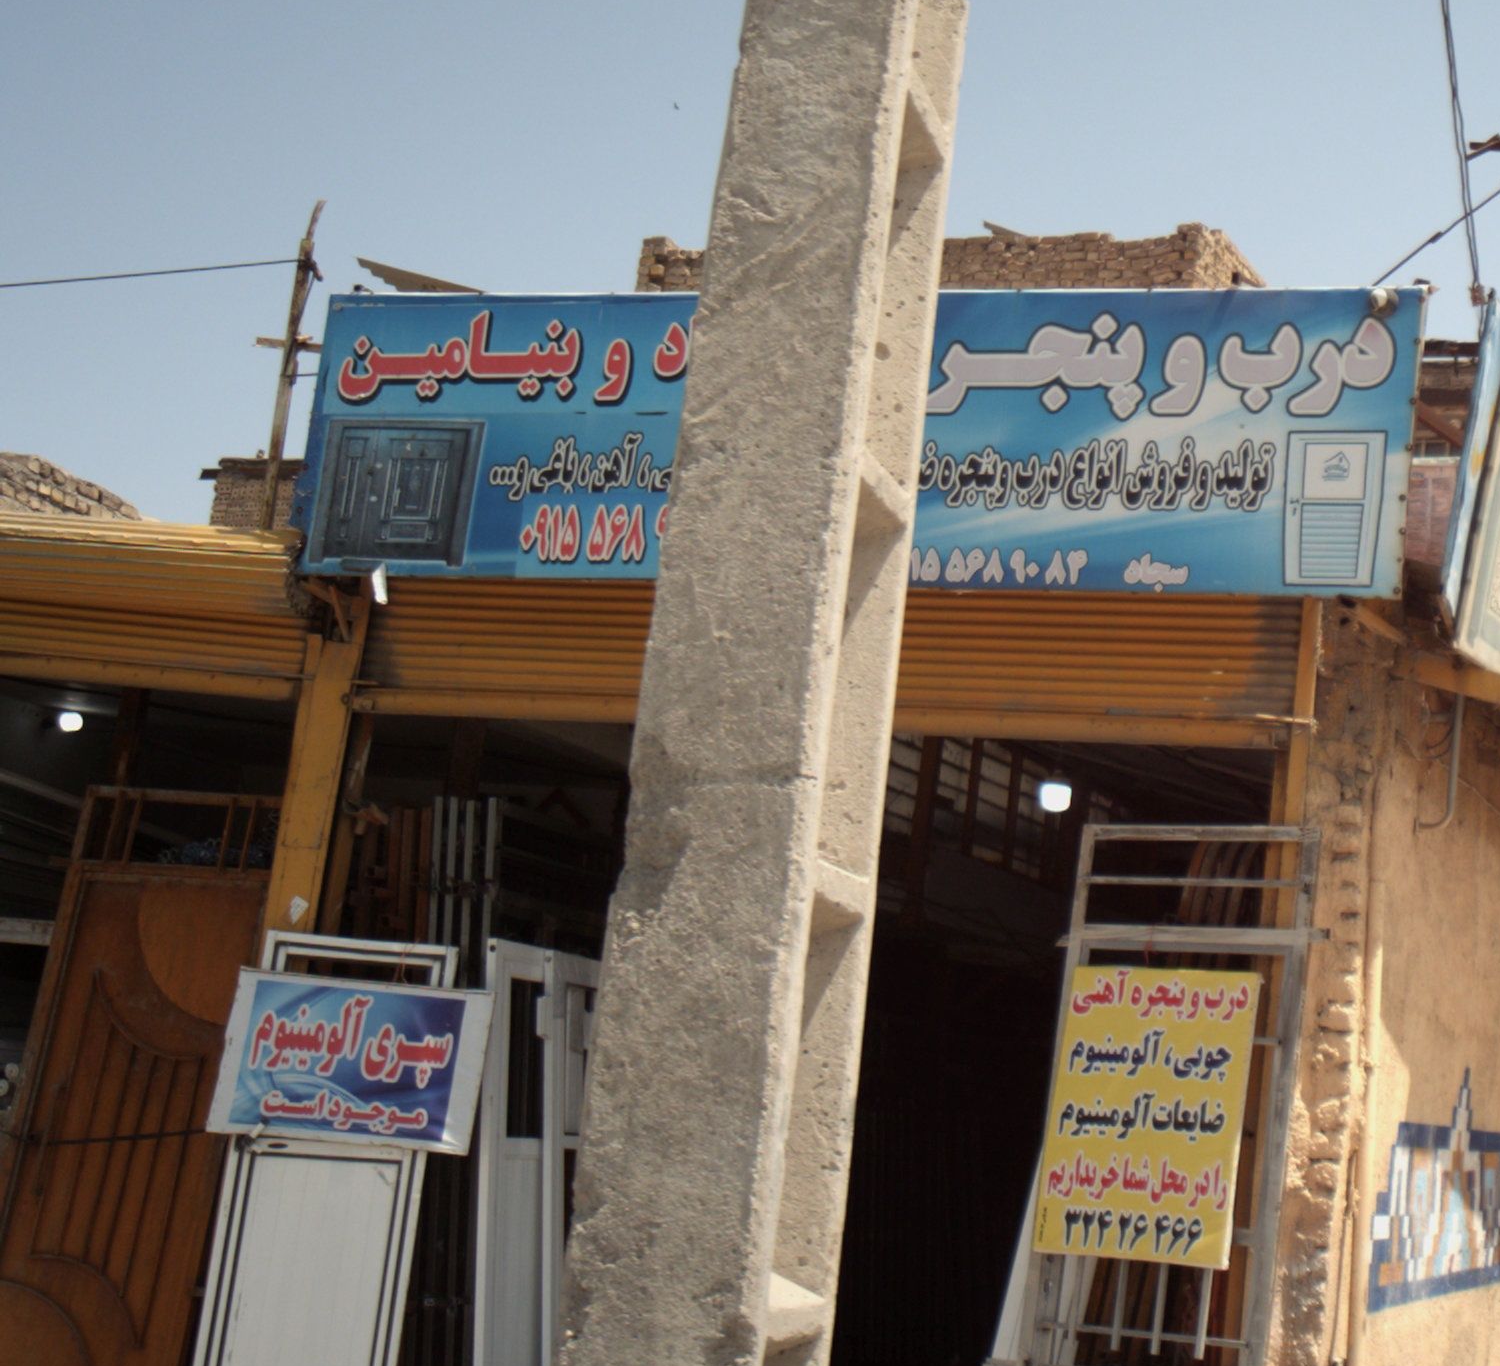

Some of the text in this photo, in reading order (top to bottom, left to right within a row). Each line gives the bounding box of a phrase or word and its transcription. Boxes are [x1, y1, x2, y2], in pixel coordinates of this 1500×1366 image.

[338, 310, 580, 400] بنیامین
[595, 339, 631, 401] و
[928, 312, 1145, 420] پنجر
[1150, 333, 1206, 416] و
[1219, 315, 1396, 417] درب
[1014, 449, 1066, 509] درب
[1063, 438, 1128, 511] انواع
[1122, 436, 1196, 510] فروش
[1190, 462, 1213, 511] و
[1213, 439, 1276, 512] تولید
[520, 504, 580, 561] ۰۹۱۵
[586, 504, 645, 561] ۵۶۸
[945, 548, 1004, 583] ۵۶۸
[1124, 553, 1189, 593] سجاد
[1071, 970, 1250, 1021] درب و پنجره آهنی
[249, 994, 453, 1089] سپری آلومینیوم
[1068, 1030, 1165, 1078] آلومینیوم
[261, 1089, 428, 1134] موجود است
[1058, 1093, 1226, 1142] ضایعات آلومینیوم
[1122, 1151, 1151, 1195] شما
[1150, 1158, 1189, 1203] محل
